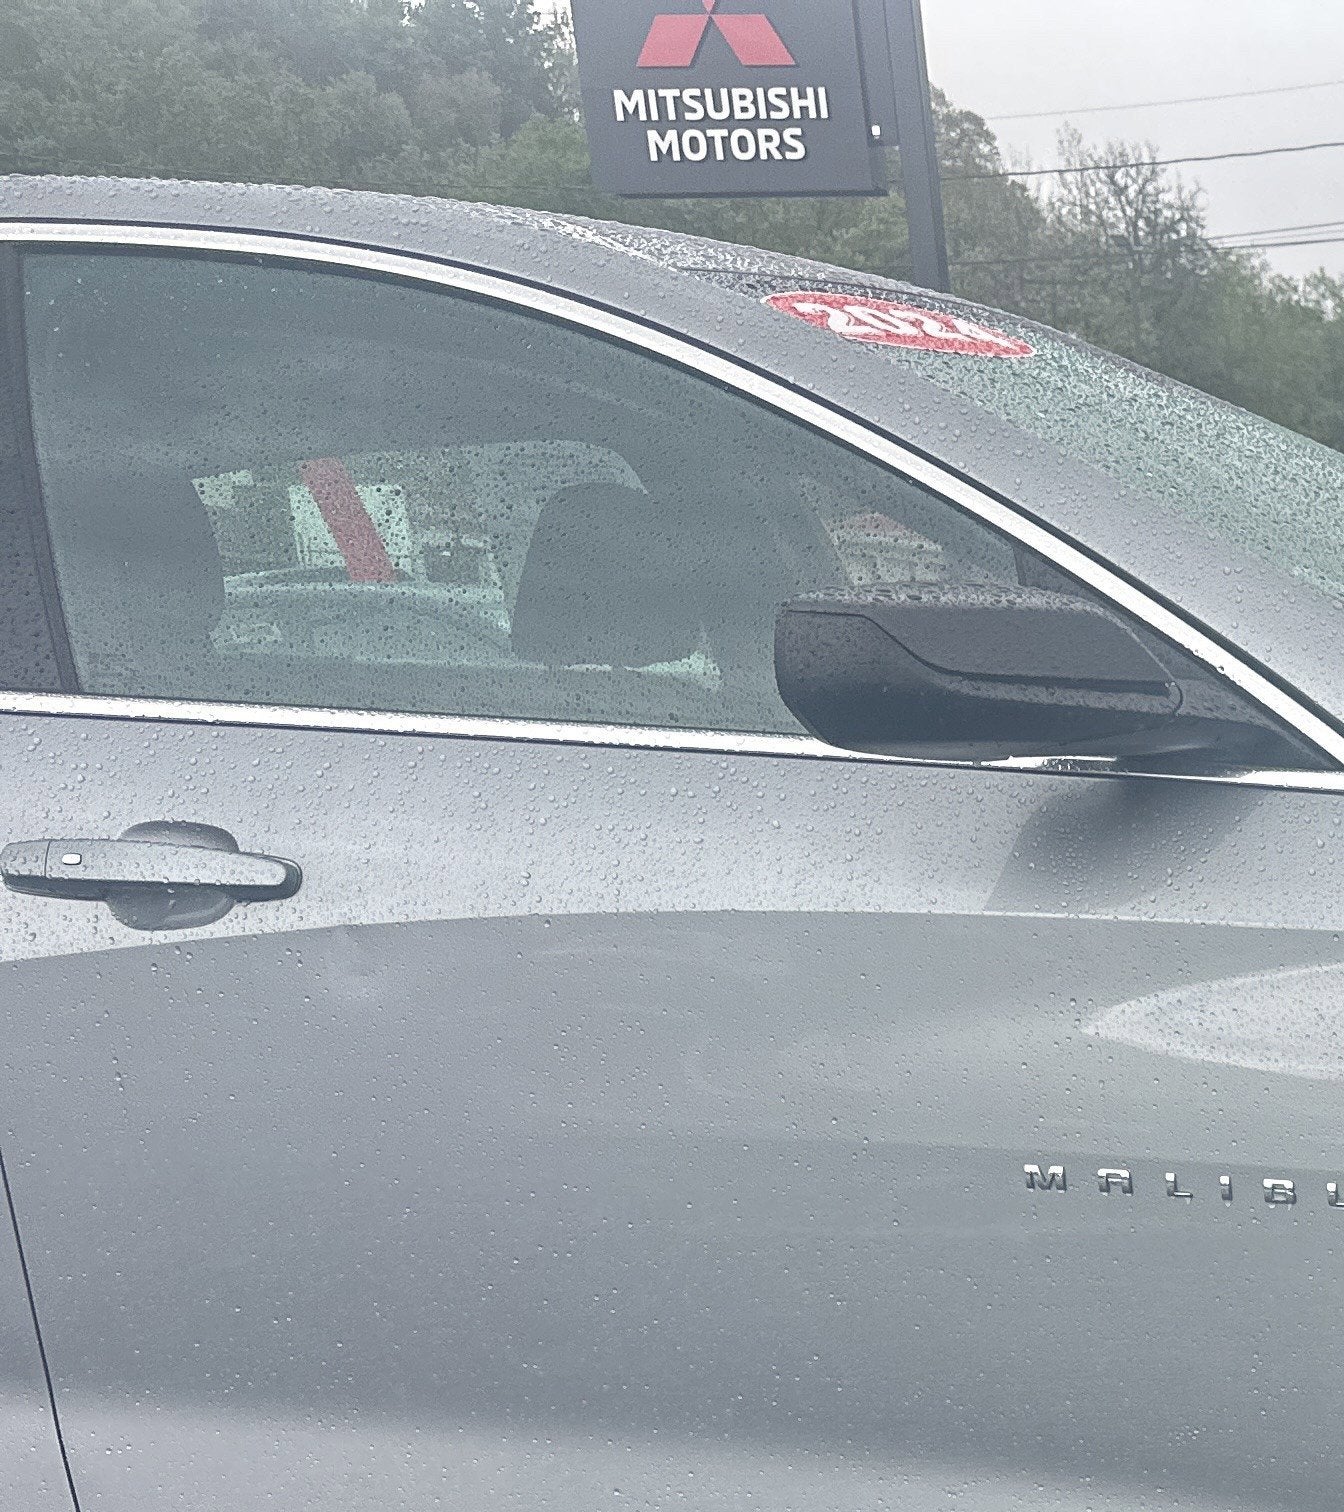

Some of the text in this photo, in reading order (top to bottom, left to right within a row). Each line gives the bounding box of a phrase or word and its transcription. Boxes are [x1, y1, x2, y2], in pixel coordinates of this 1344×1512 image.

[613, 86, 829, 122] MITSUBISHI
[646, 127, 807, 162] MOTORS
[793, 302, 1024, 350] 2024
